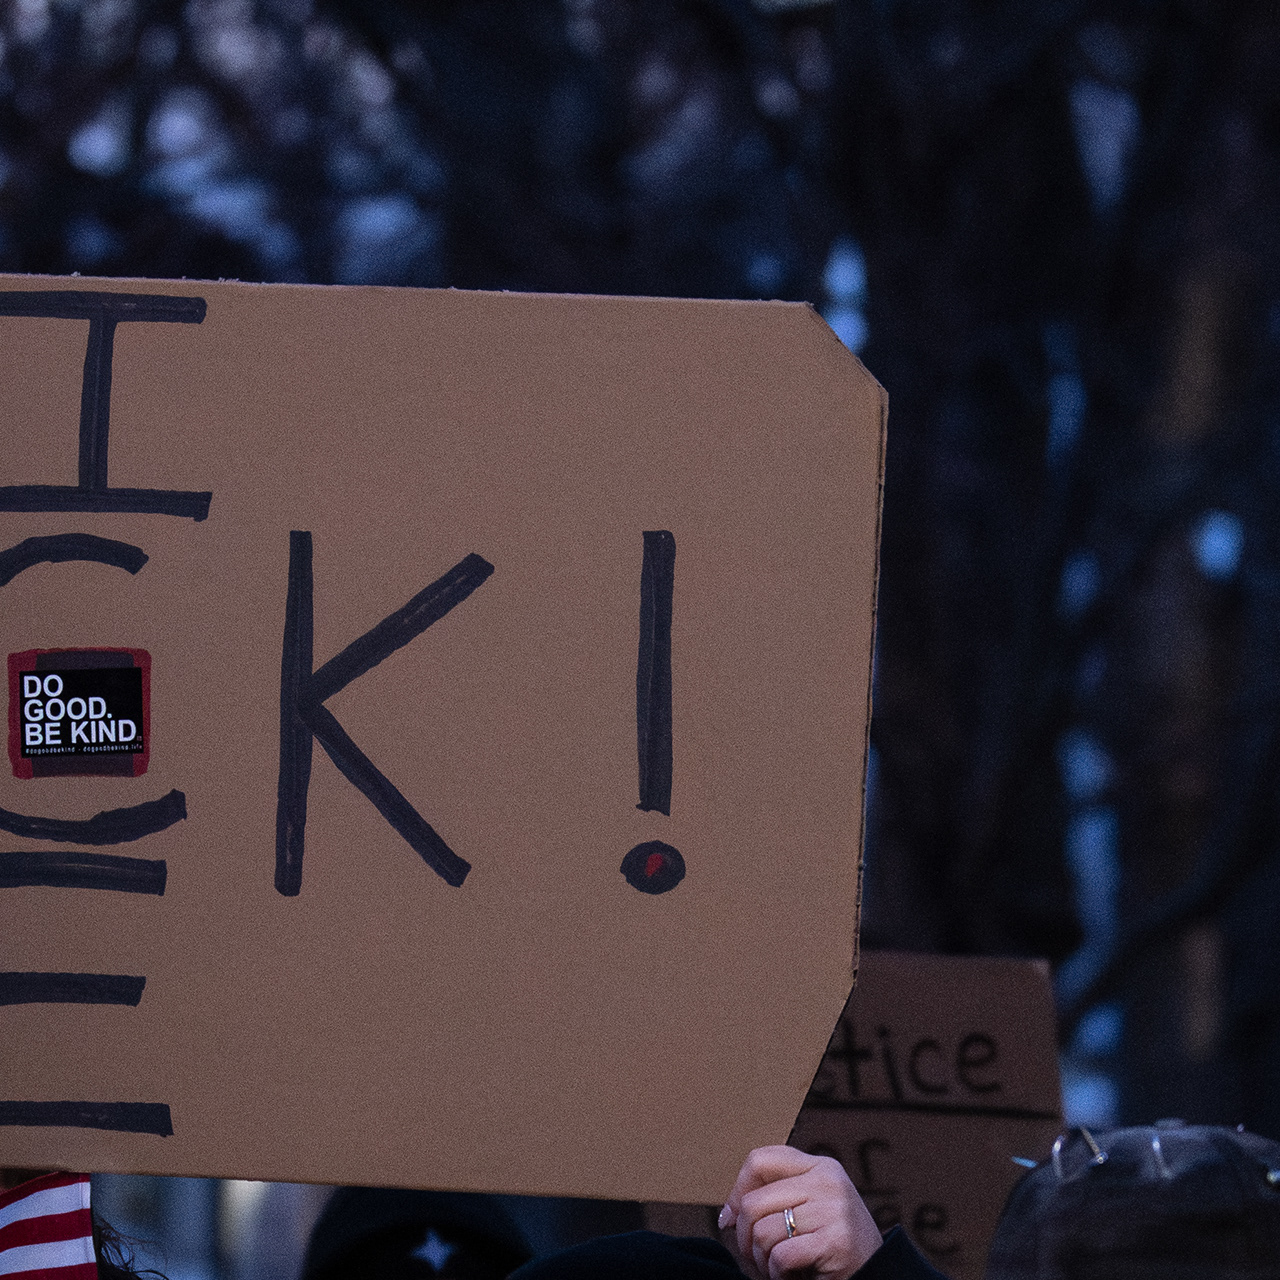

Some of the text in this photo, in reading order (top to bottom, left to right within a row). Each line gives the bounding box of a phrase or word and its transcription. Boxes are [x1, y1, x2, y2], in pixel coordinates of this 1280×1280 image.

[23, 674, 64, 698] DO
[23, 696, 113, 722] GOOD.
[24, 722, 62, 746] BE
